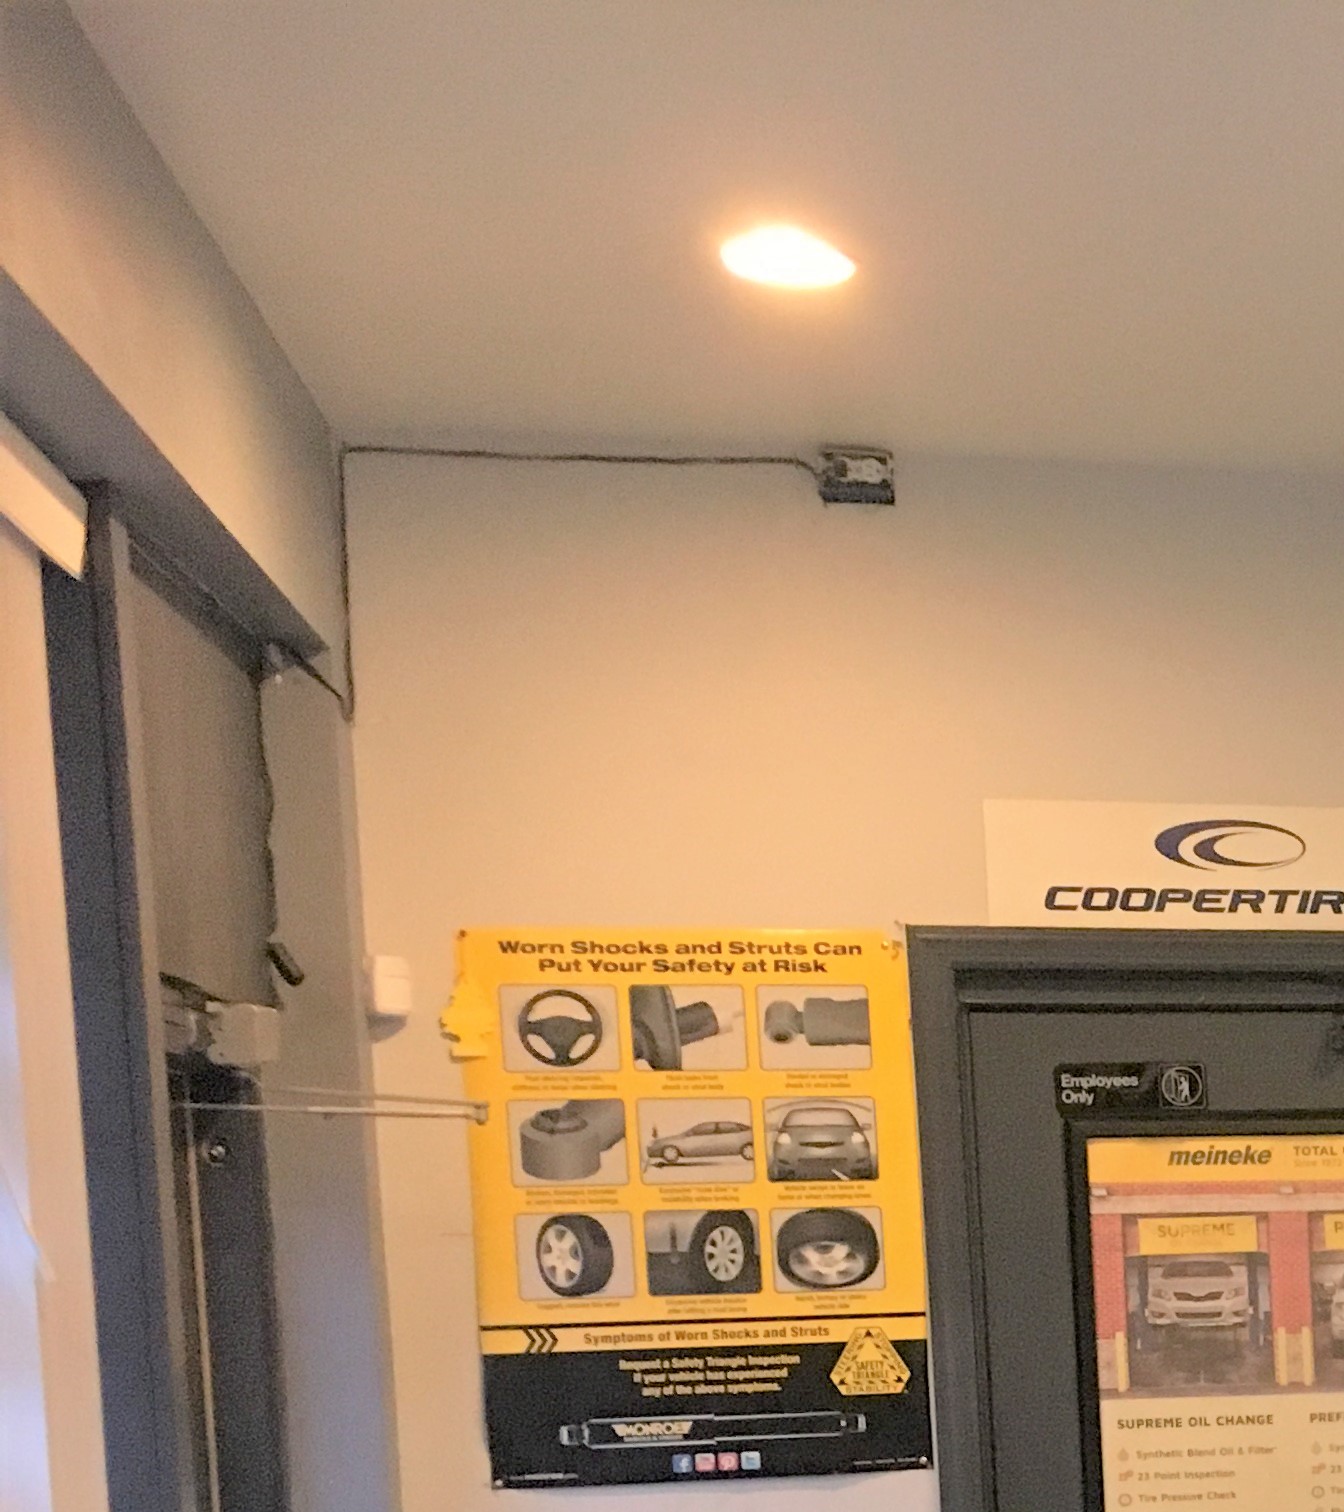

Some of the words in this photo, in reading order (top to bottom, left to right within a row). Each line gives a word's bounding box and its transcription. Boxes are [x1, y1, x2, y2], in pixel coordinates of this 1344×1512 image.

[499, 941, 564, 955] Worn
[571, 940, 668, 955] Shocks
[675, 940, 721, 955] and
[728, 941, 807, 955] Struts
[813, 942, 862, 956] Can
[539, 959, 581, 973] Put
[588, 959, 646, 973] Your
[653, 959, 734, 976] Safety
[742, 960, 767, 973] at
[773, 959, 827, 973] Risk
[1061, 1073, 1138, 1089] Employees
[1061, 1089, 1094, 1106] Only
[1168, 1145, 1272, 1166] meineke
[1293, 1145, 1338, 1157] TOTAL
[1157, 1223, 1235, 1238] SUPREME
[584, 1331, 653, 1346] Symptoms
[658, 1331, 671, 1342] of
[675, 1330, 708, 1341] Worn
[712, 1328, 759, 1340] Shocks
[763, 1327, 786, 1338] and
[791, 1326, 829, 1337] Struts
[1117, 1417, 1183, 1430] SUPREME
[1188, 1416, 1211, 1427] OIL
[1216, 1414, 1274, 1426] CHANGE
[1154, 1471, 1181, 1480] Point
[1184, 1470, 1236, 1481] Inspection
